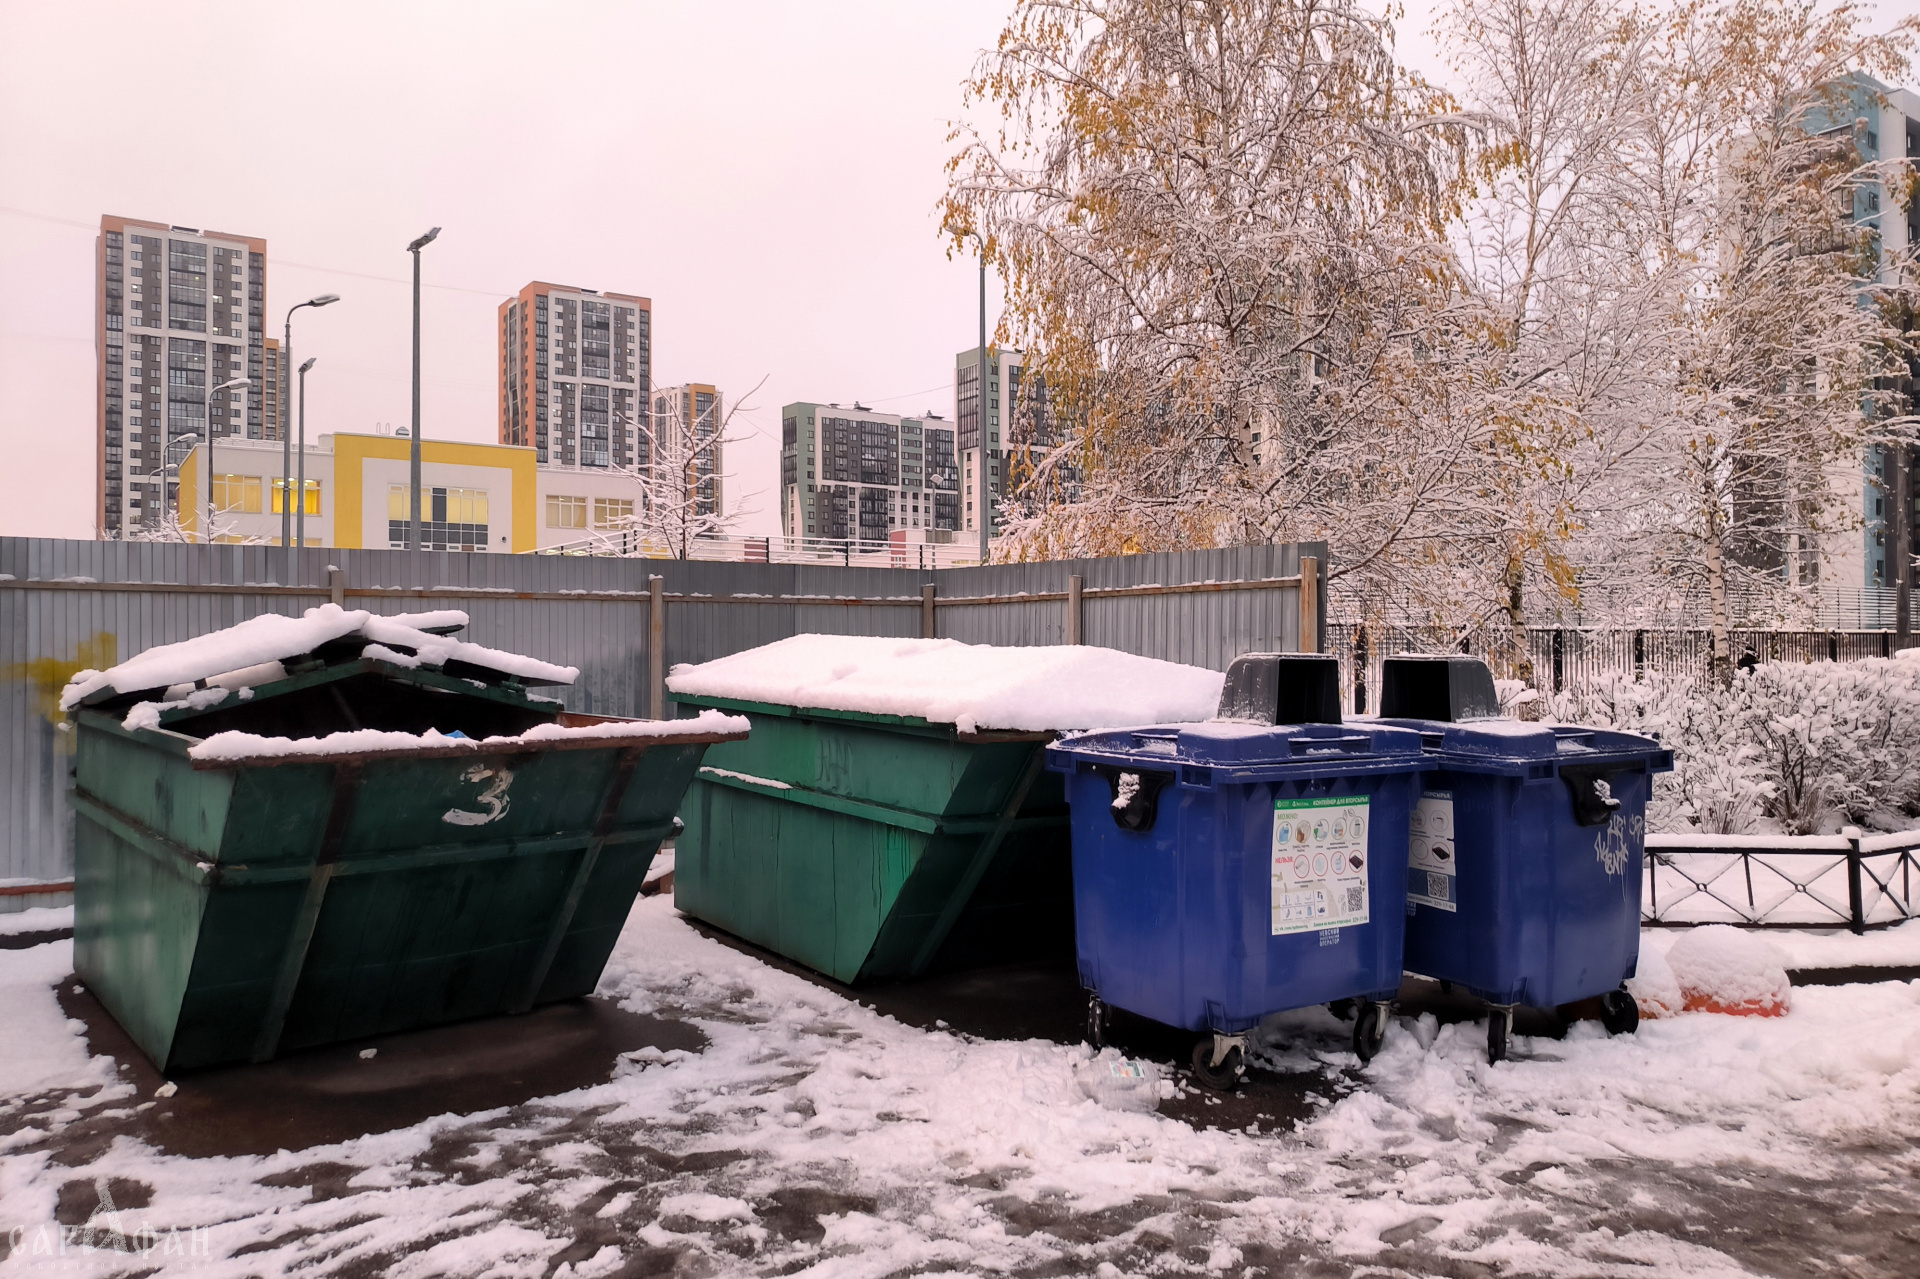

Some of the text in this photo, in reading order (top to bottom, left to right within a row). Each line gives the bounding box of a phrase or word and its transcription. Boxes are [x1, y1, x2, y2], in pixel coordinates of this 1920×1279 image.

[442, 763, 514, 826] 3
[1423, 790, 1451, 799] ТОРСЫРЬЯ
[1313, 798, 1337, 806] КОНТЕЙНЕР
[1345, 796, 1368, 804] ВТОРСЫРЬЯ
[1319, 938, 1340, 947] ОПЕРАТОР
